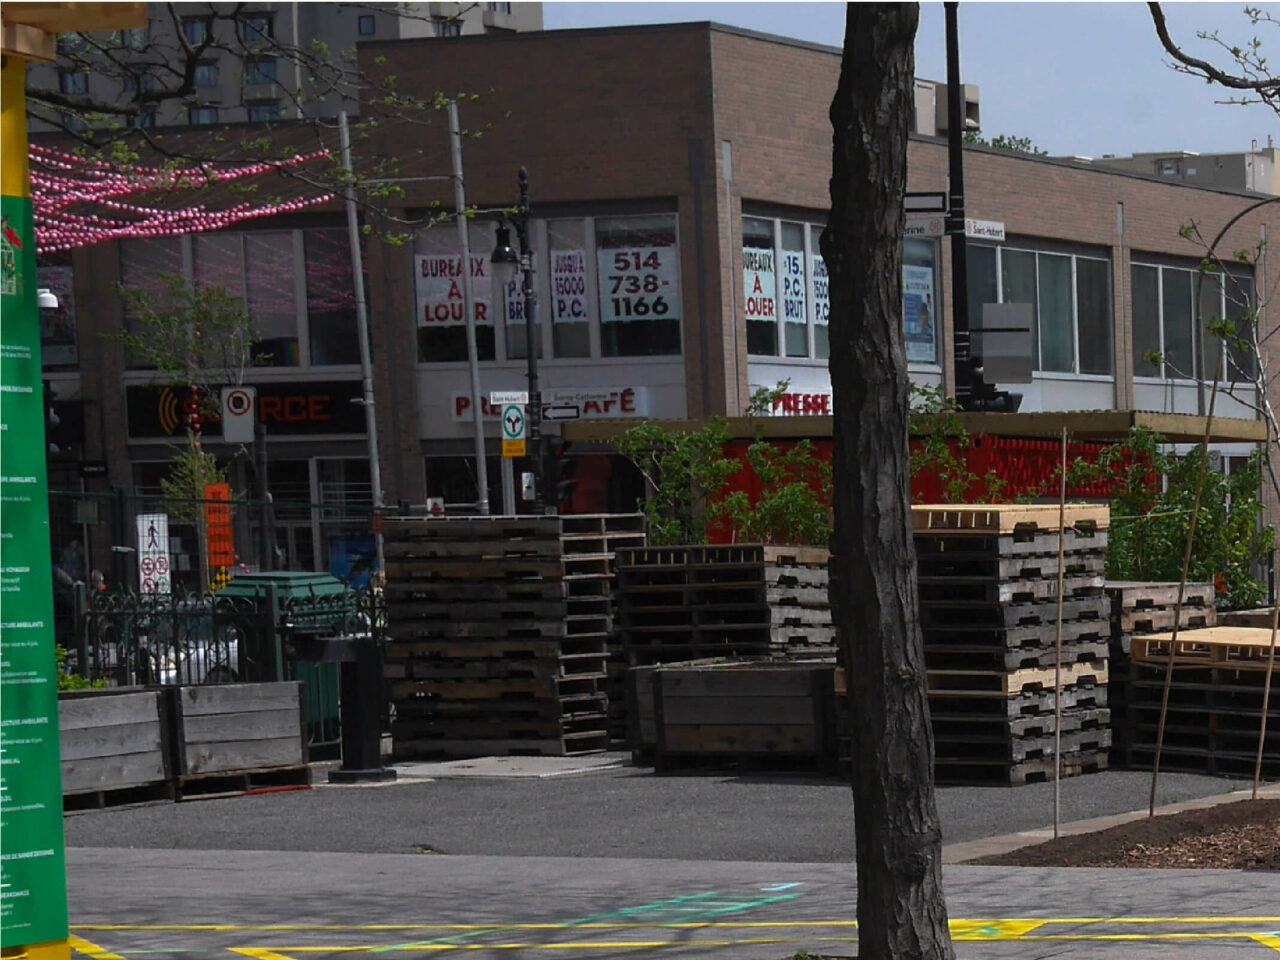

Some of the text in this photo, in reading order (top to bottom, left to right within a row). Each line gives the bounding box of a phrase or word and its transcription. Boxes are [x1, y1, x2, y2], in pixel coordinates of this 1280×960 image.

[421, 257, 485, 277] BUREAX
[614, 251, 661, 271] 514
[447, 278, 463, 301] À
[608, 274, 670, 294] 738-
[753, 271, 763, 294] À
[424, 303, 487, 322] LOUR
[558, 300, 587, 318] P.C.
[613, 297, 669, 317] 1166
[745, 297, 774, 316] OUER
[785, 300, 804, 318] BRUT
